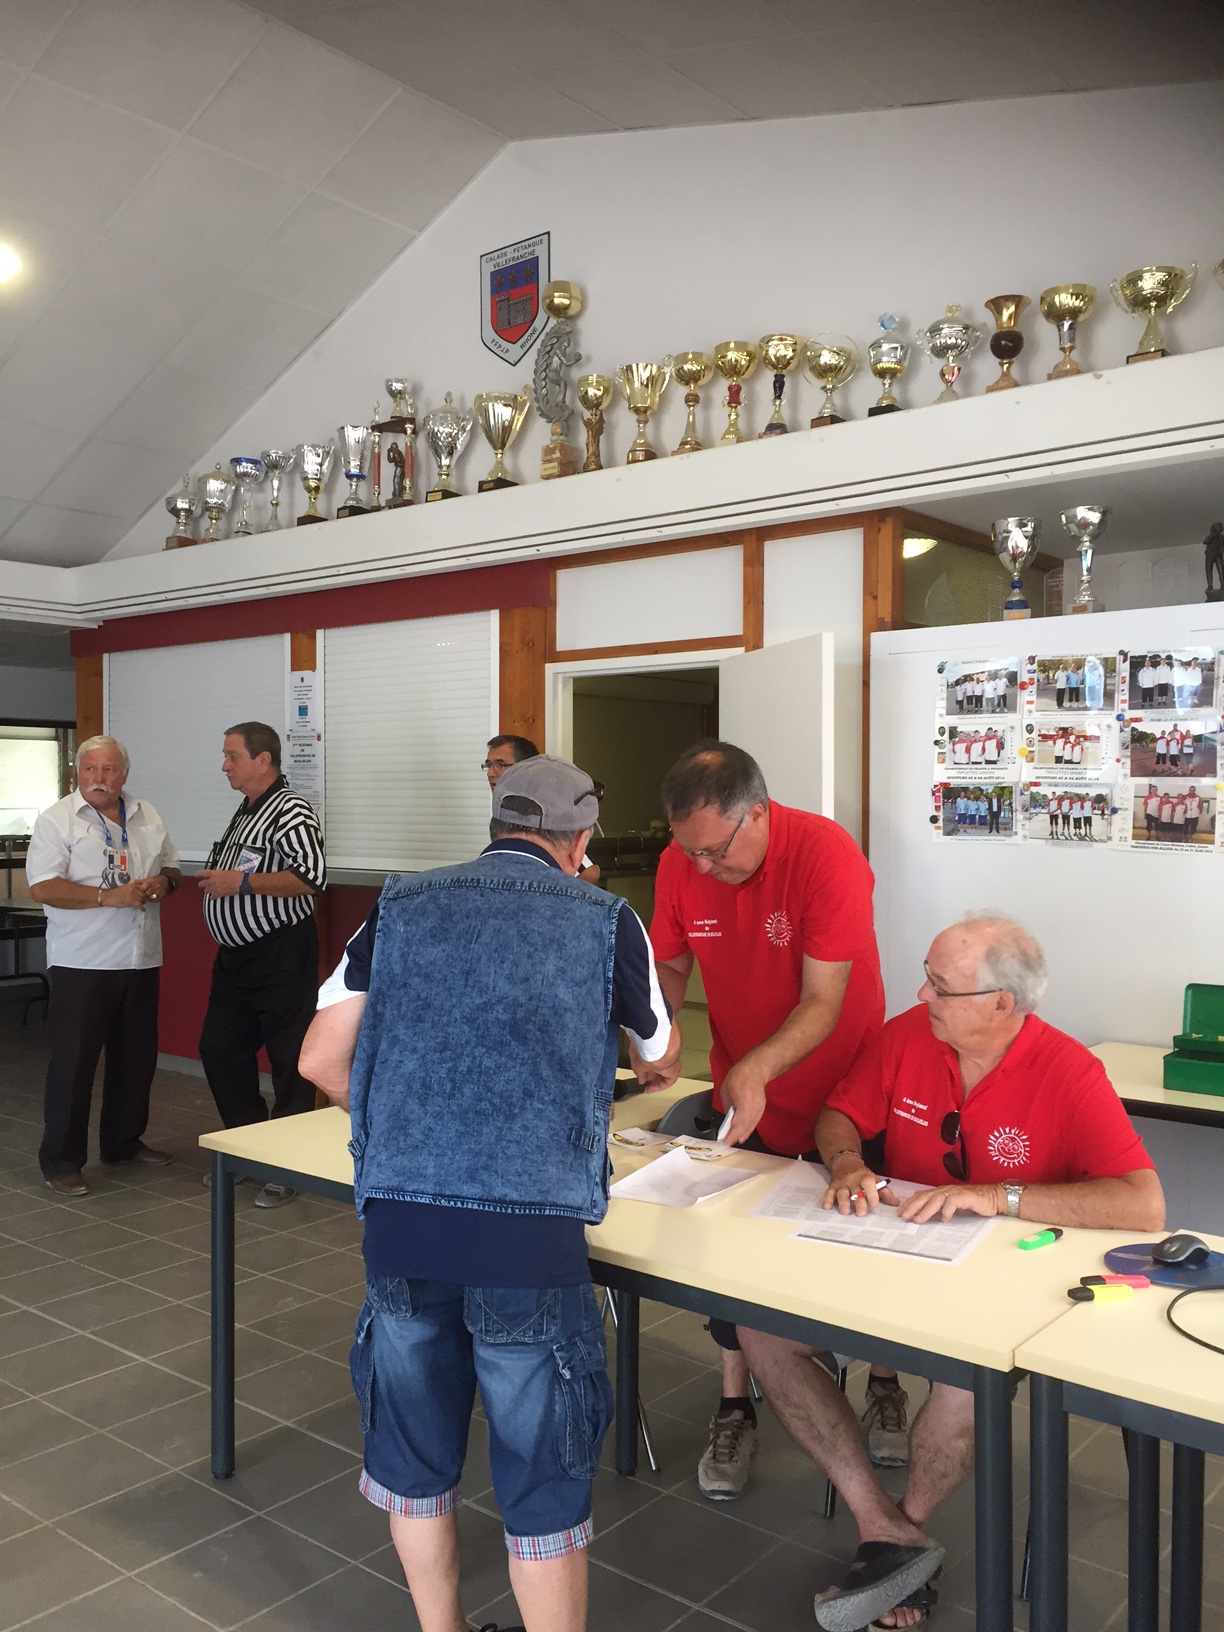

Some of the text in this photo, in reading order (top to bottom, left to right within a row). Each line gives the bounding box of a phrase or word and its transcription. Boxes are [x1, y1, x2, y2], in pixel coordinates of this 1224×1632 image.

[485, 250, 508, 264] CALADE
[513, 238, 544, 254] PETANQUE
[493, 248, 536, 269] VILLEFRANCHE
[520, 326, 538, 351] RHONE
